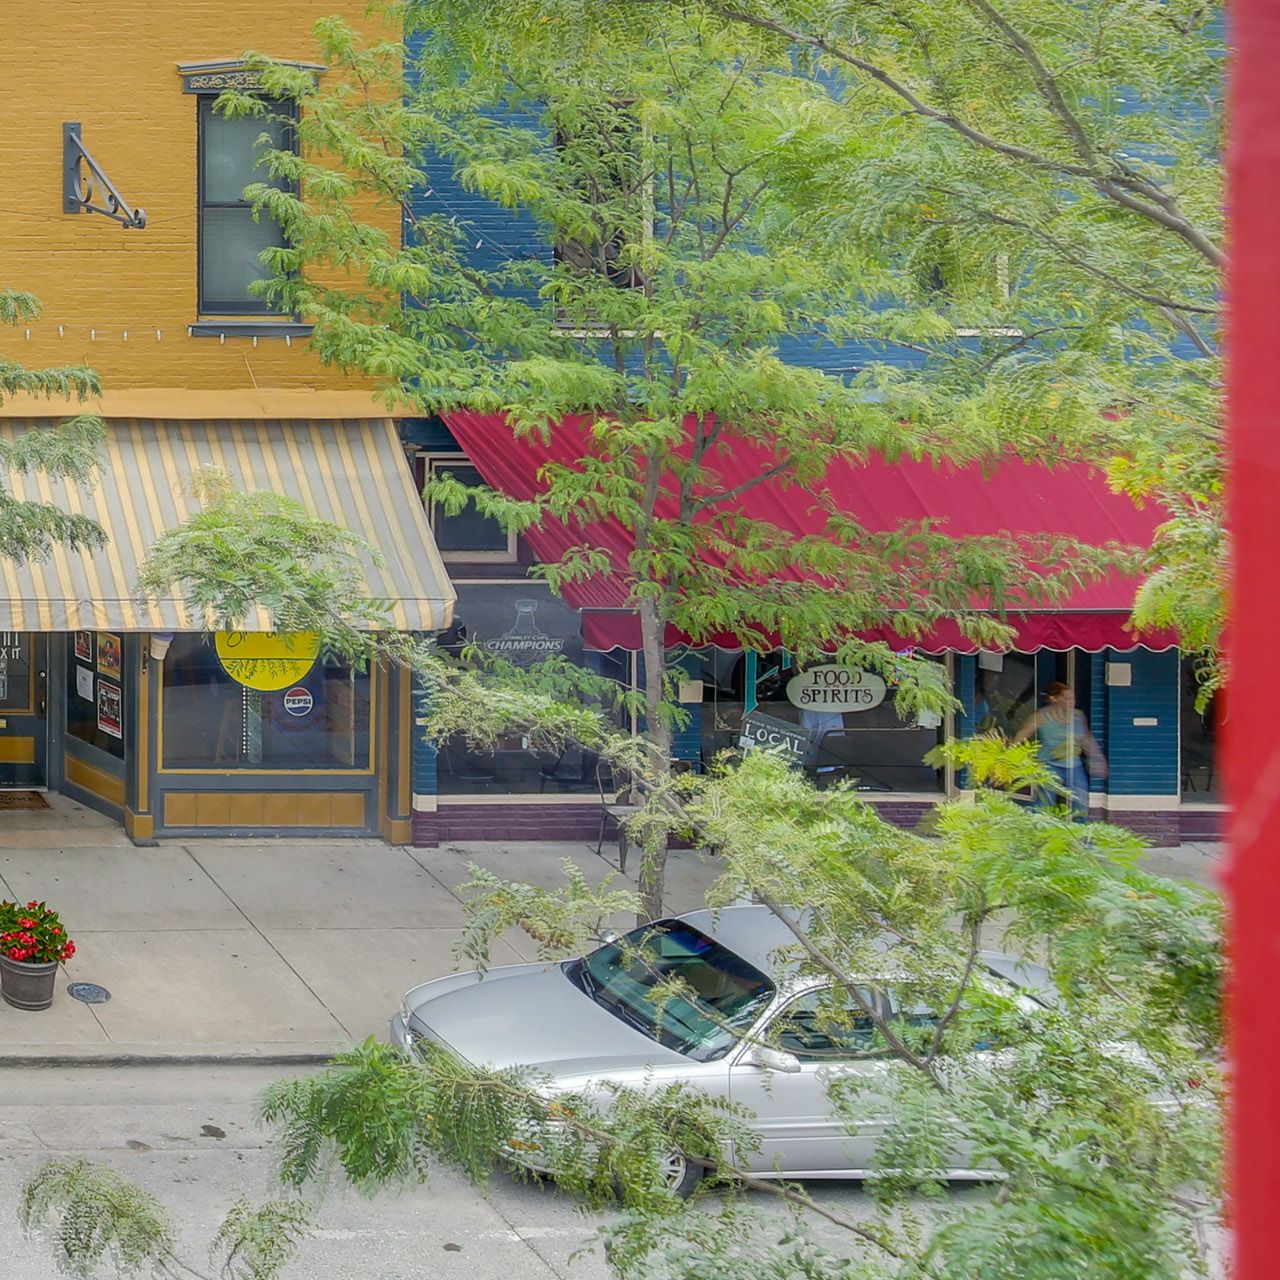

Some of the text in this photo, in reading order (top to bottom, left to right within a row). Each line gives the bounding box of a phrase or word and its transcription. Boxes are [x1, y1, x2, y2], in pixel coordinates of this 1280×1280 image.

[487, 640, 561, 650] CHAMPIONS
[12, 647, 21, 659] IT
[813, 670, 862, 685] FOOD
[800, 688, 873, 704] SPIRITS
[744, 723, 803, 755] LOCAL
